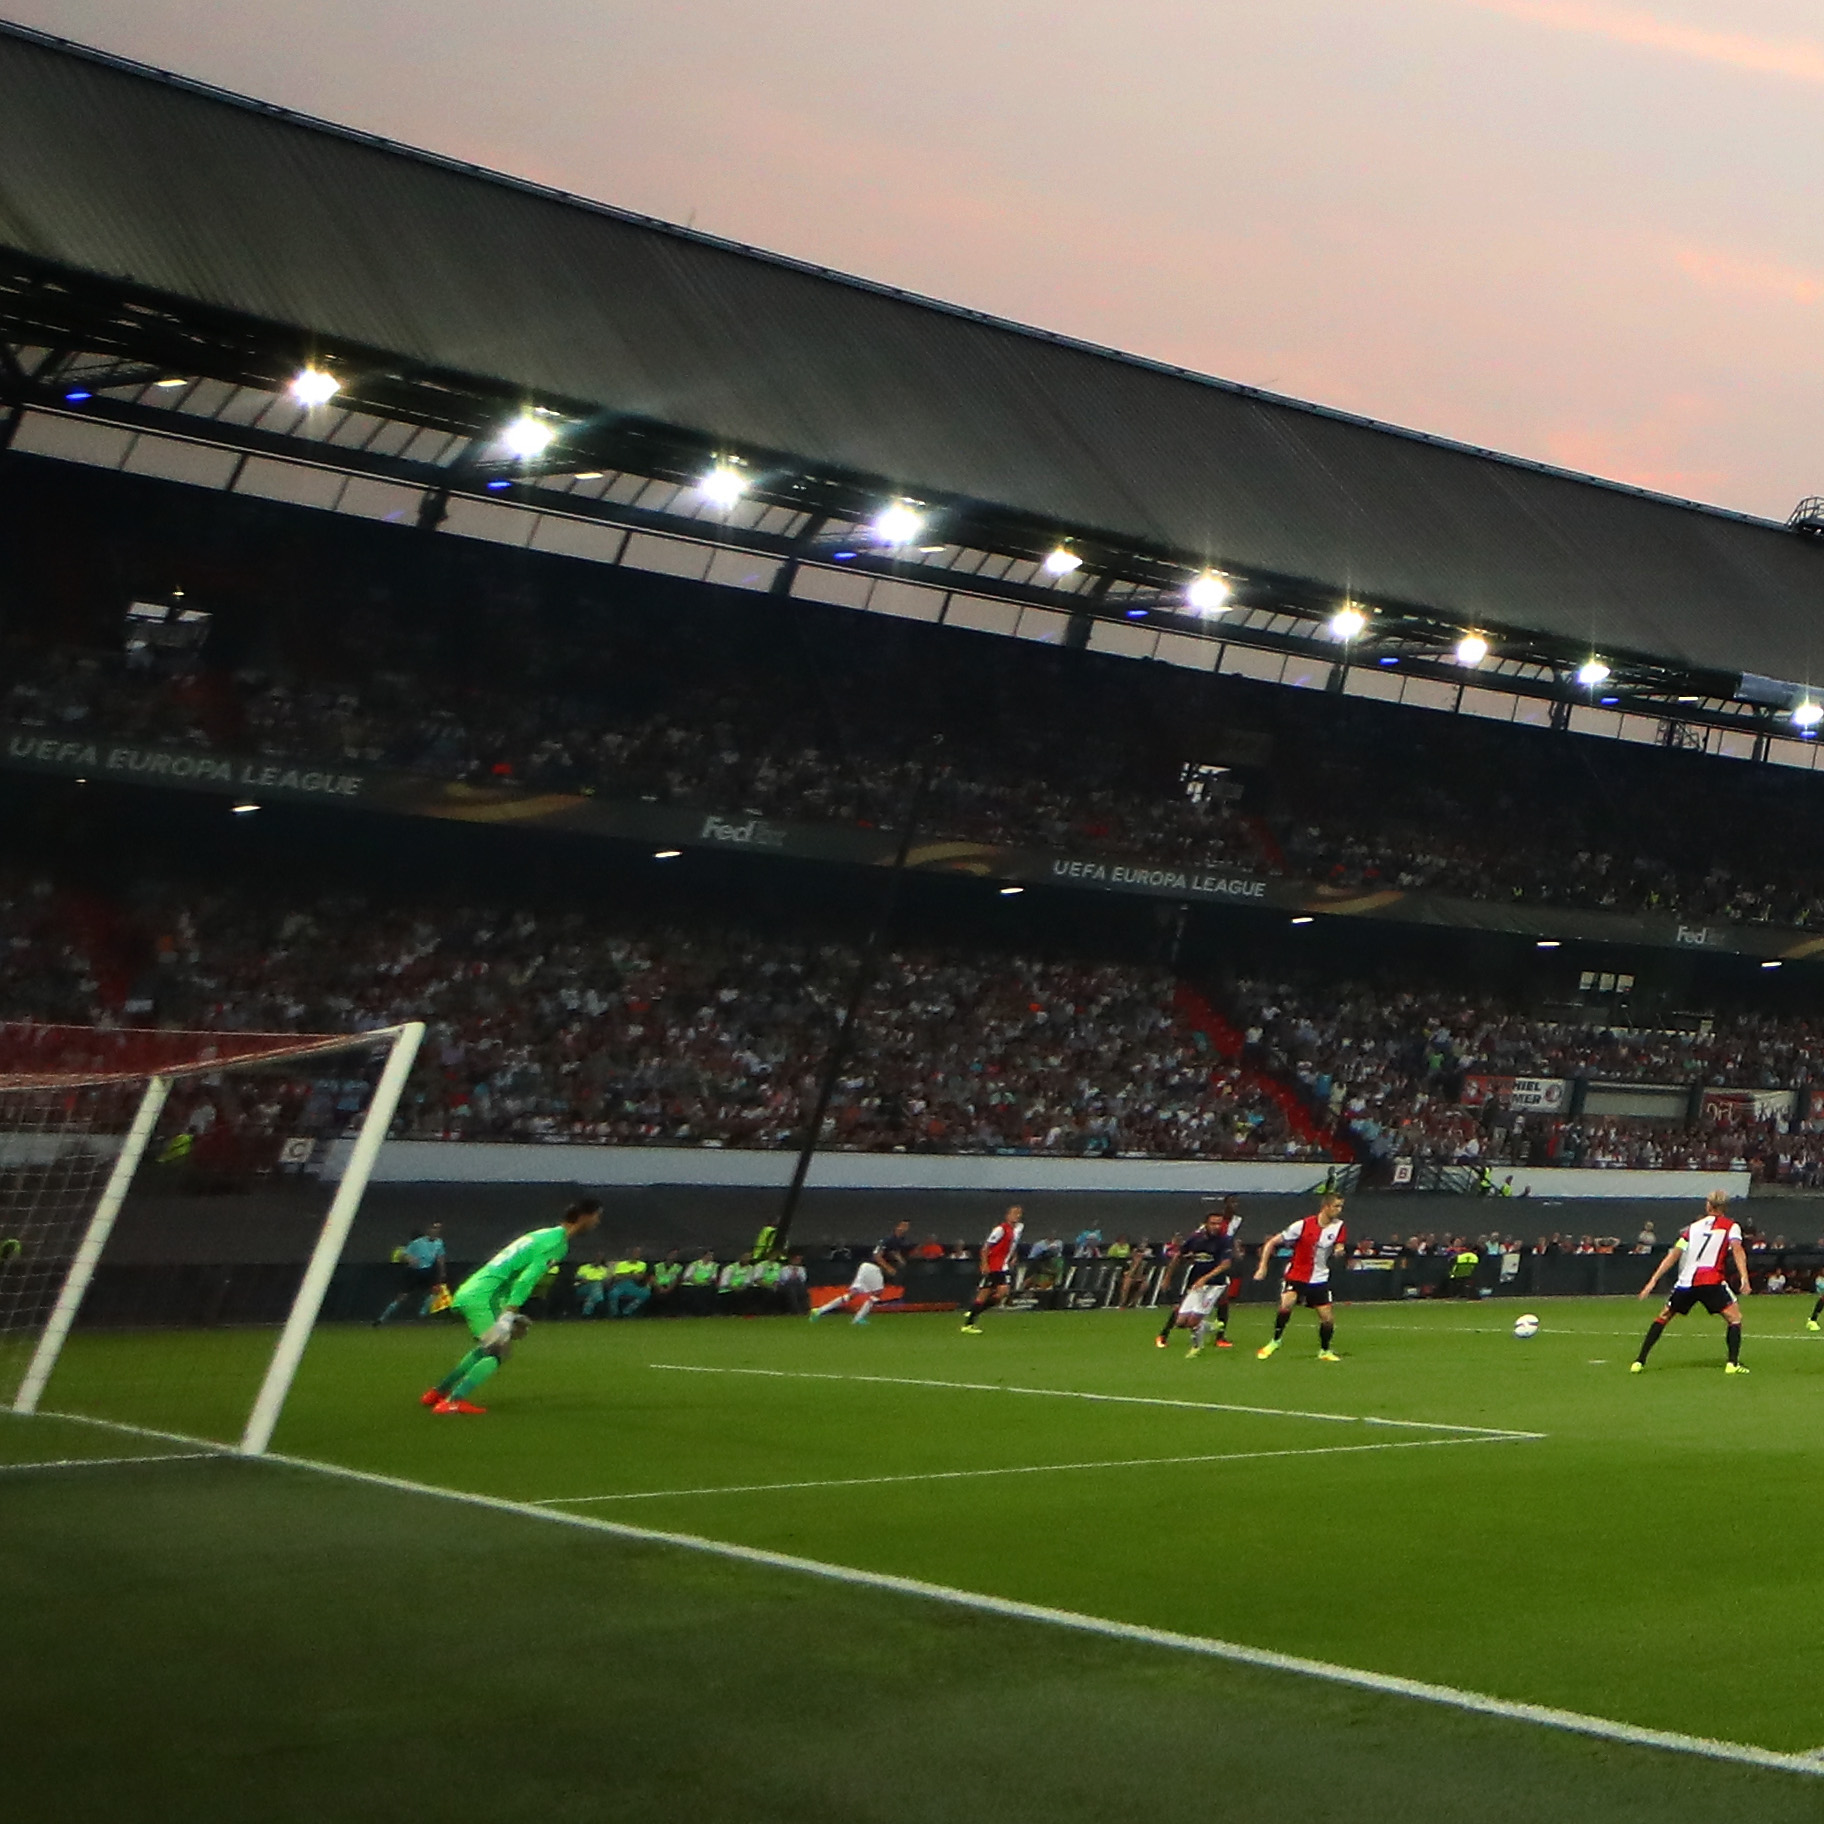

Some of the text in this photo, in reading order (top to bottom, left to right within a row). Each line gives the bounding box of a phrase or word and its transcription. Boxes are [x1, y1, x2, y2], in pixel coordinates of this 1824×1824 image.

[8, 736, 366, 796] UEFA EUROPA LEAGUE
[1053, 859, 1267, 897] UEFA EUROPA LEAGUE
[1696, 1232, 1713, 1261] 7
